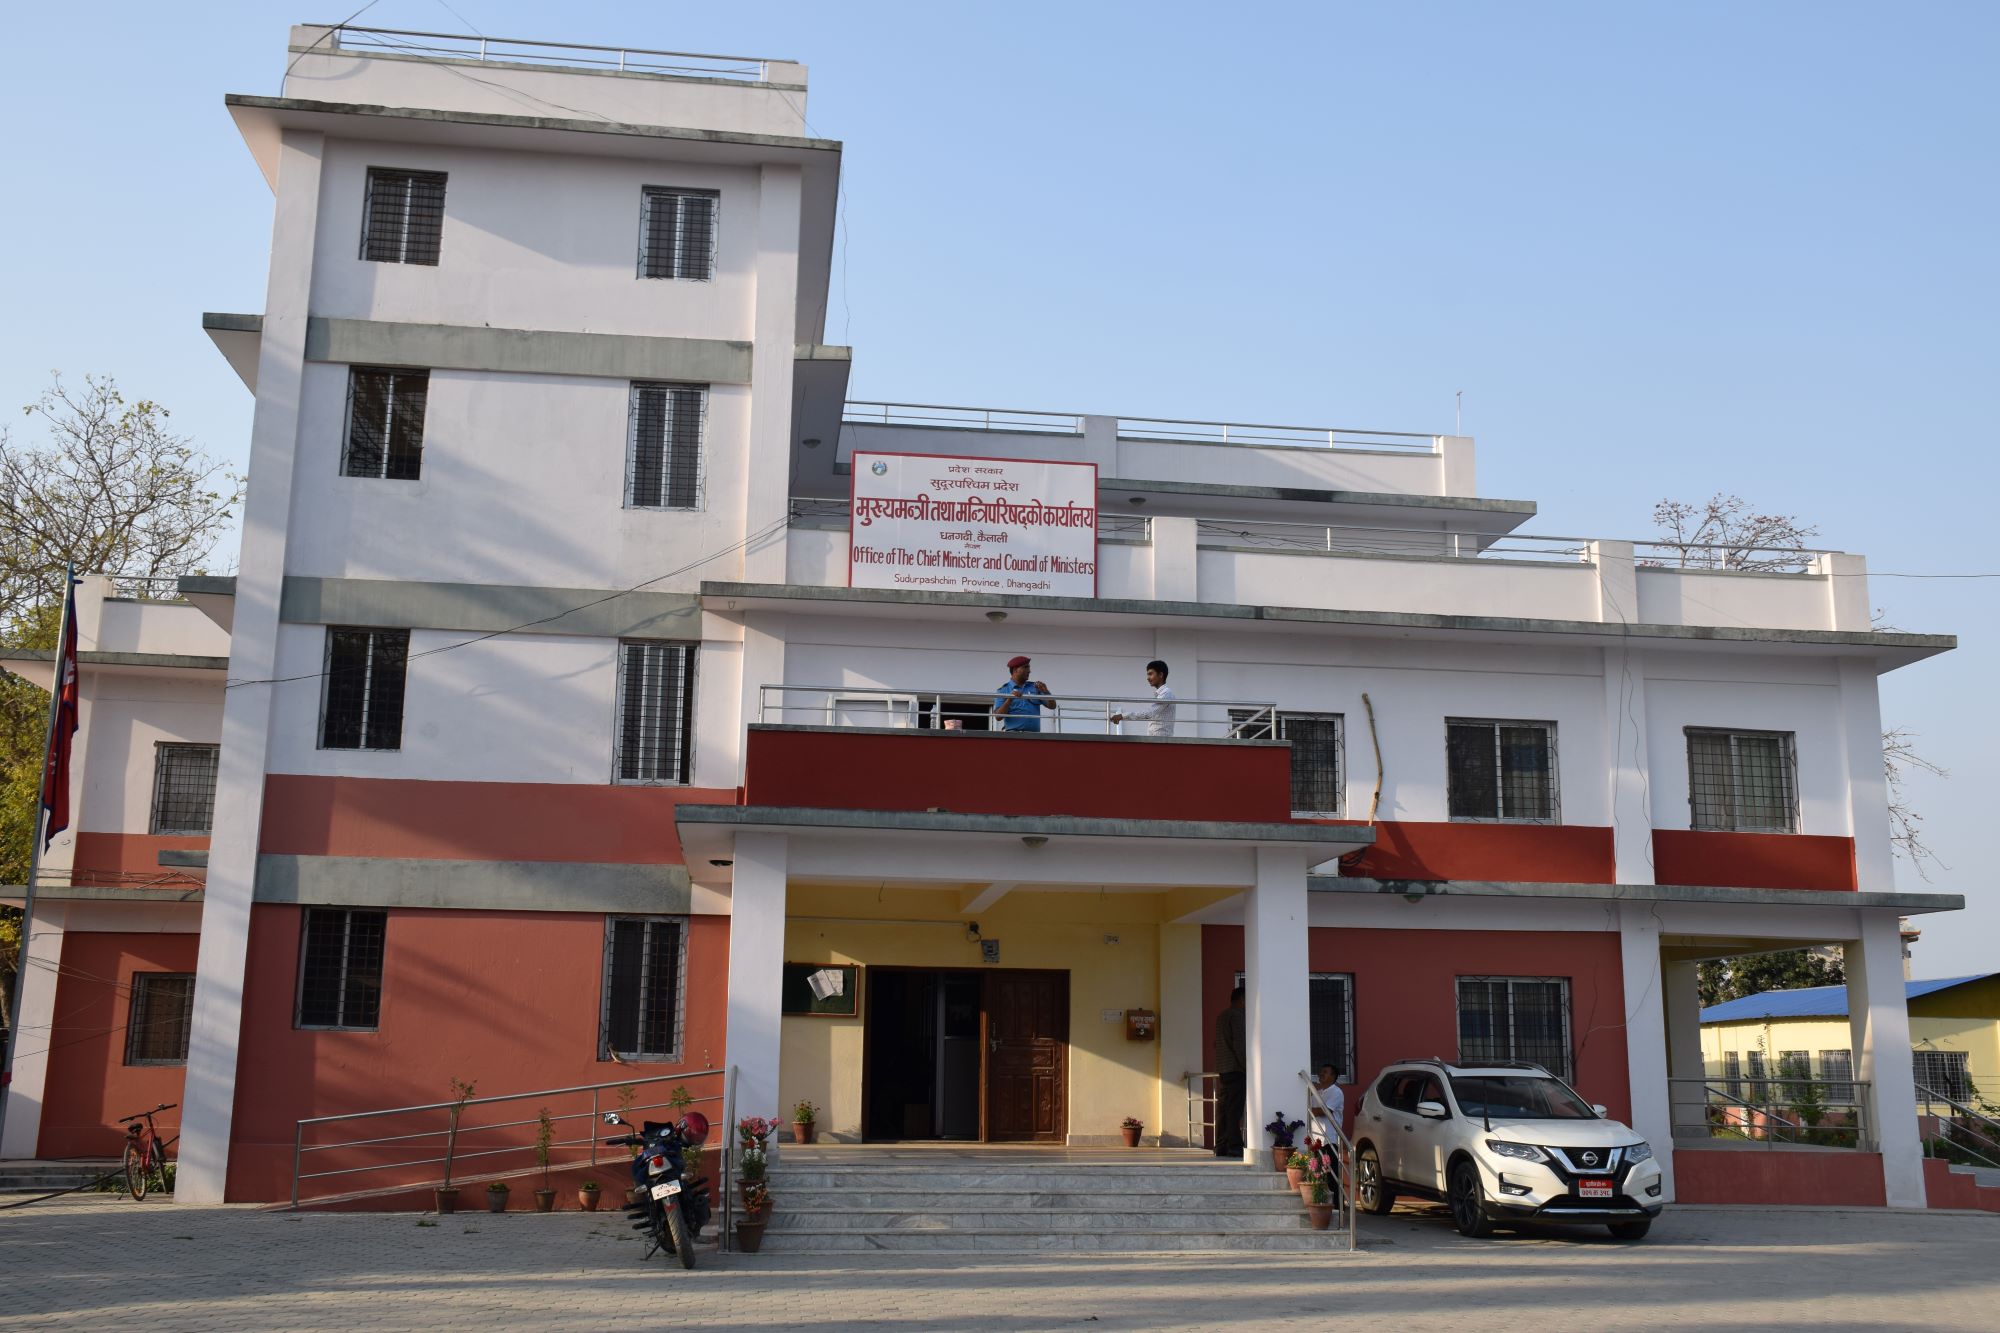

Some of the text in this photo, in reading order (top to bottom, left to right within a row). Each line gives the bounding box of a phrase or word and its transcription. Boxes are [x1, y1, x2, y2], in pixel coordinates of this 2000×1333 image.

[948, 464, 1004, 475] प्रदेश सरकार
[930, 477, 1020, 491] सुदूरपश्चिम प्रदेश
[856, 493, 931, 526] मुख्यमन्त्री
[931, 501, 955, 522] तथा
[1043, 500, 1094, 528] कार्यालय
[977, 530, 1008, 543] कैलाली
[853, 546, 1094, 575] Office of The Chief Minister and Council of Ministers
[894, 574, 957, 585] Sudurpashchim
[1007, 578, 1051, 591] Dhangadhi
